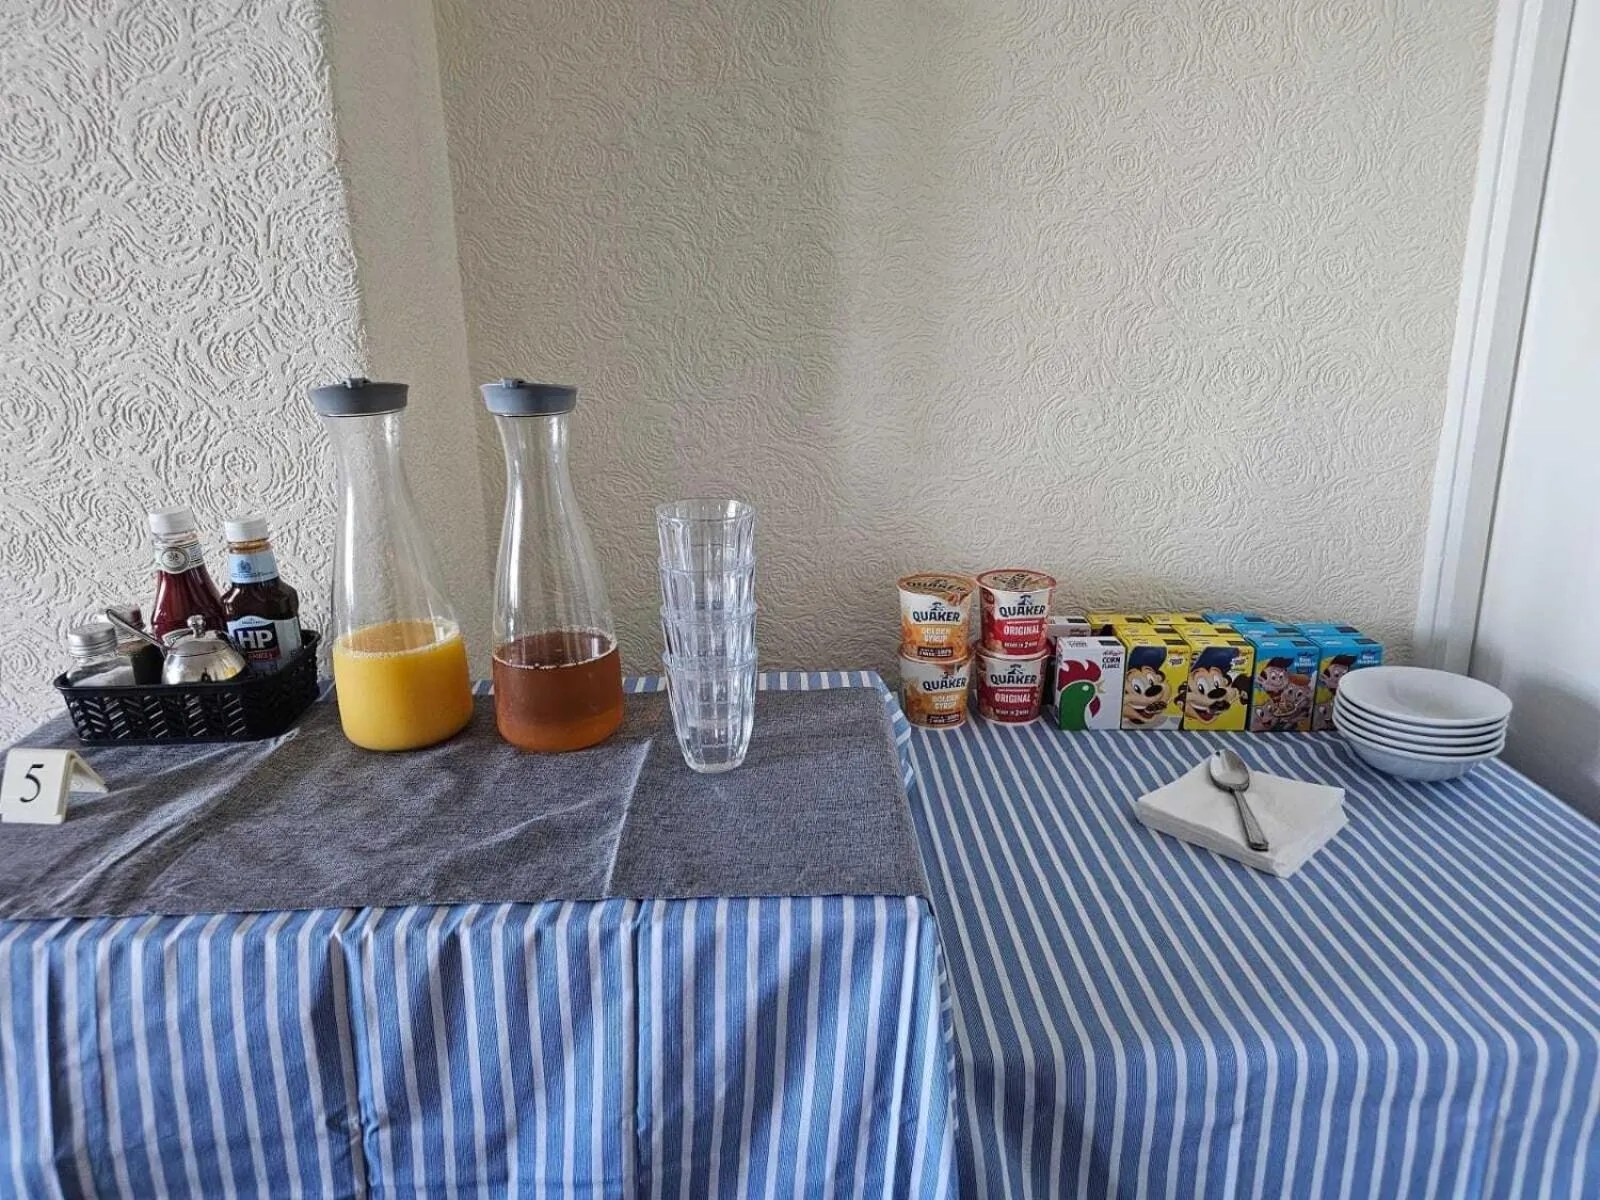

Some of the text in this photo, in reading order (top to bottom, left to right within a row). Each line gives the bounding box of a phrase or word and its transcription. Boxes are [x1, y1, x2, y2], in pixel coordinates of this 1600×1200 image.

[912, 611, 960, 622] QUAKER
[999, 605, 1046, 617] QUAKER
[1003, 625, 1039, 635] ORIGINAL
[236, 629, 273, 649] HP
[922, 677, 966, 691] QUAKER
[990, 674, 1037, 685] QUAKER
[995, 693, 1031, 703] ORIGINAL
[20, 764, 44, 803] 5
